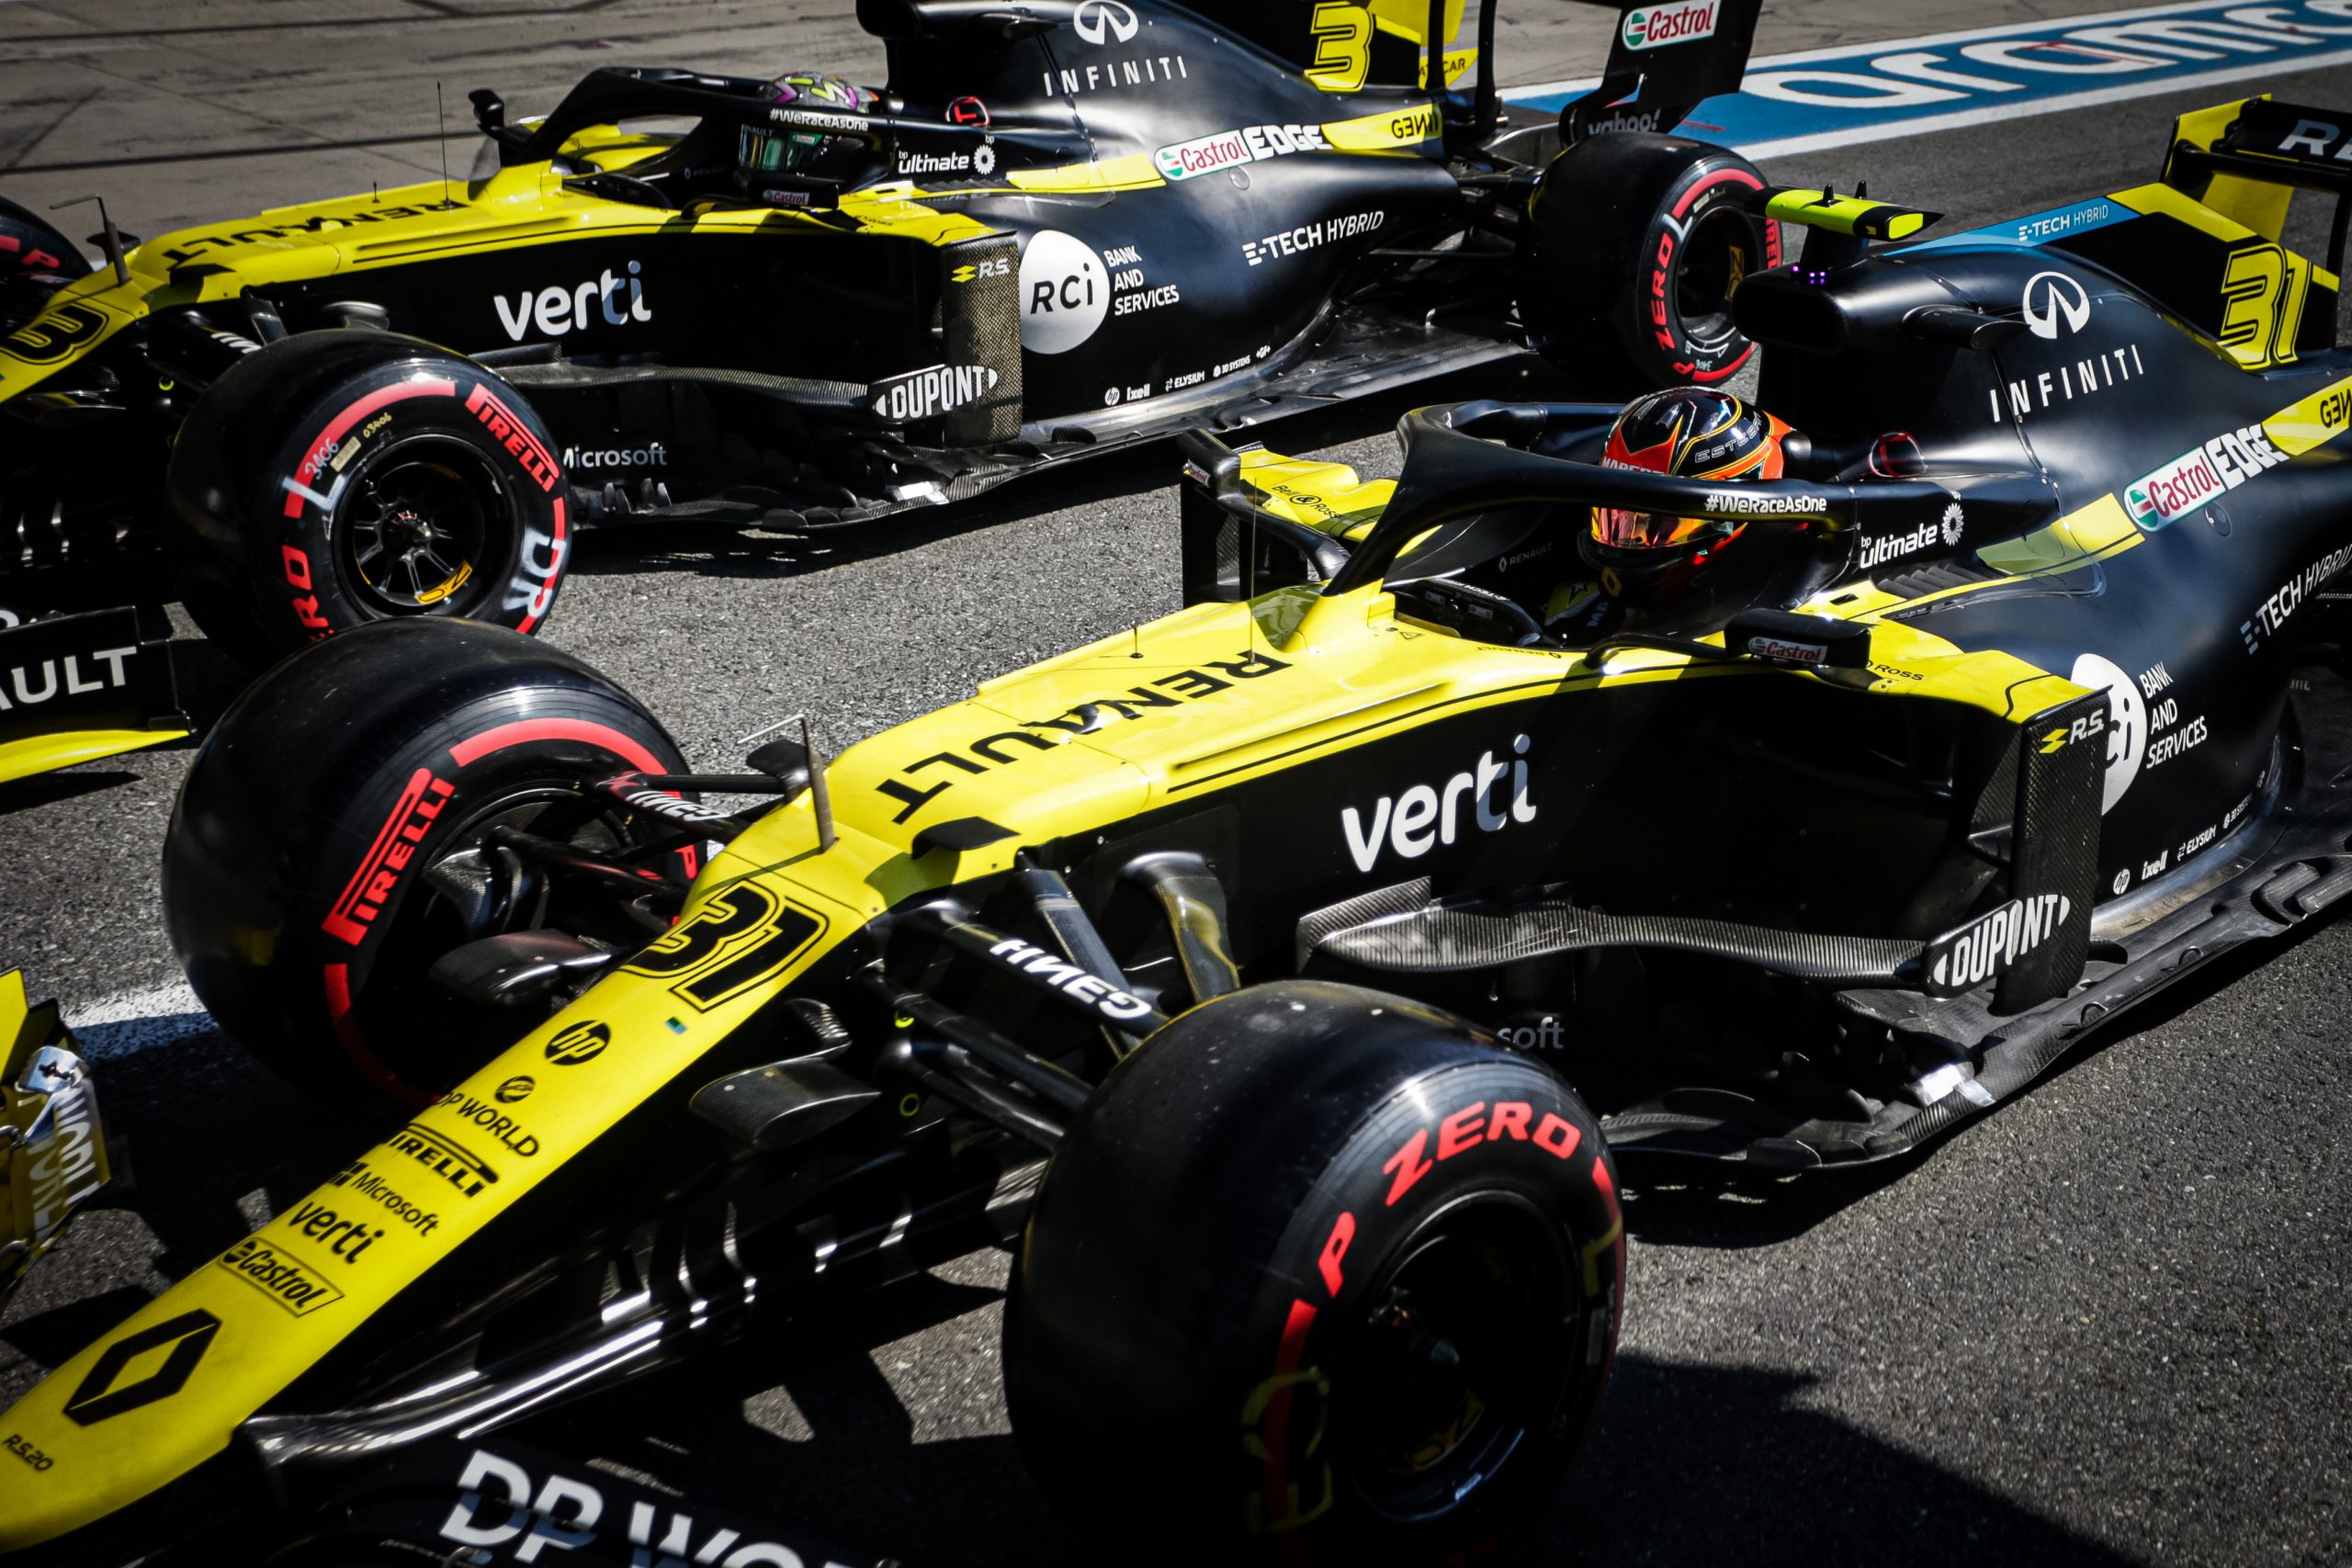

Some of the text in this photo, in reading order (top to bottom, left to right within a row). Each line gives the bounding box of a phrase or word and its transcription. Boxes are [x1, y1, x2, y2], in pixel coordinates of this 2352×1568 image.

[1304, 1, 1374, 92] 3
[1646, 2, 1715, 42] Castrol
[1044, 55, 1188, 97] INFINITI
[769, 108, 869, 132] #WeRaceAsOne
[985, 135, 995, 145] bp
[899, 150, 909, 161] bp
[899, 152, 970, 175] ultimate
[1181, 124, 1334, 173] Castrol EDGE
[773, 191, 808, 206] Castrol
[2018, 204, 2109, 243] E-TECH HYBRID
[1103, 245, 1143, 268] BANK
[1242, 210, 1385, 266] E-TECH HYBRID
[493, 260, 652, 342] verti
[1030, 263, 1094, 315] RCi
[1114, 268, 1145, 292] AND
[1114, 285, 1181, 316] SERVICES
[1650, 232, 1677, 351] ZERO
[2216, 243, 2313, 370] 31
[0, 302, 109, 366] 3
[891, 366, 986, 419] DUPONT
[1105, 387, 1120, 406] hp
[1174, 370, 1205, 389] ELYSIUM
[1989, 344, 2144, 423] INFINITI
[304, 437, 340, 480] 3406
[464, 382, 560, 493] PIRELLI
[2148, 423, 2290, 519] Castrol EDGE
[1704, 494, 1827, 514] #WeRaceAsOne
[1509, 543, 1553, 566] RENAULT
[1860, 536, 1872, 549] bp
[1860, 523, 1939, 570] ultimate
[2240, 574, 2301, 656] E-TECH
[1765, 641, 1823, 663] Castrol
[2139, 661, 2174, 699] BANK
[876, 649, 1294, 825] RENAULT
[2146, 716, 2208, 770] SERVICES
[2150, 698, 2178, 735] AND
[1340, 734, 1537, 873] verti
[322, 767, 457, 947] PIRELLI
[2113, 868, 2132, 896] hp
[2142, 850, 2169, 881] ixell
[2187, 824, 2217, 854] ELYSIUM
[620, 878, 828, 1013] 31
[1951, 894, 2058, 987] DUPONT
[544, 1020, 611, 1066] hp
[457, 1097, 540, 1158] WORLD
[1383, 1101, 1582, 1207] ZERO
[352, 1170, 442, 1238] Microsoft
[288, 1201, 386, 1265] verti
[1317, 1211, 1357, 1299] P
[237, 1245, 326, 1309] Castrol
[439, 1449, 605, 1563] DP
